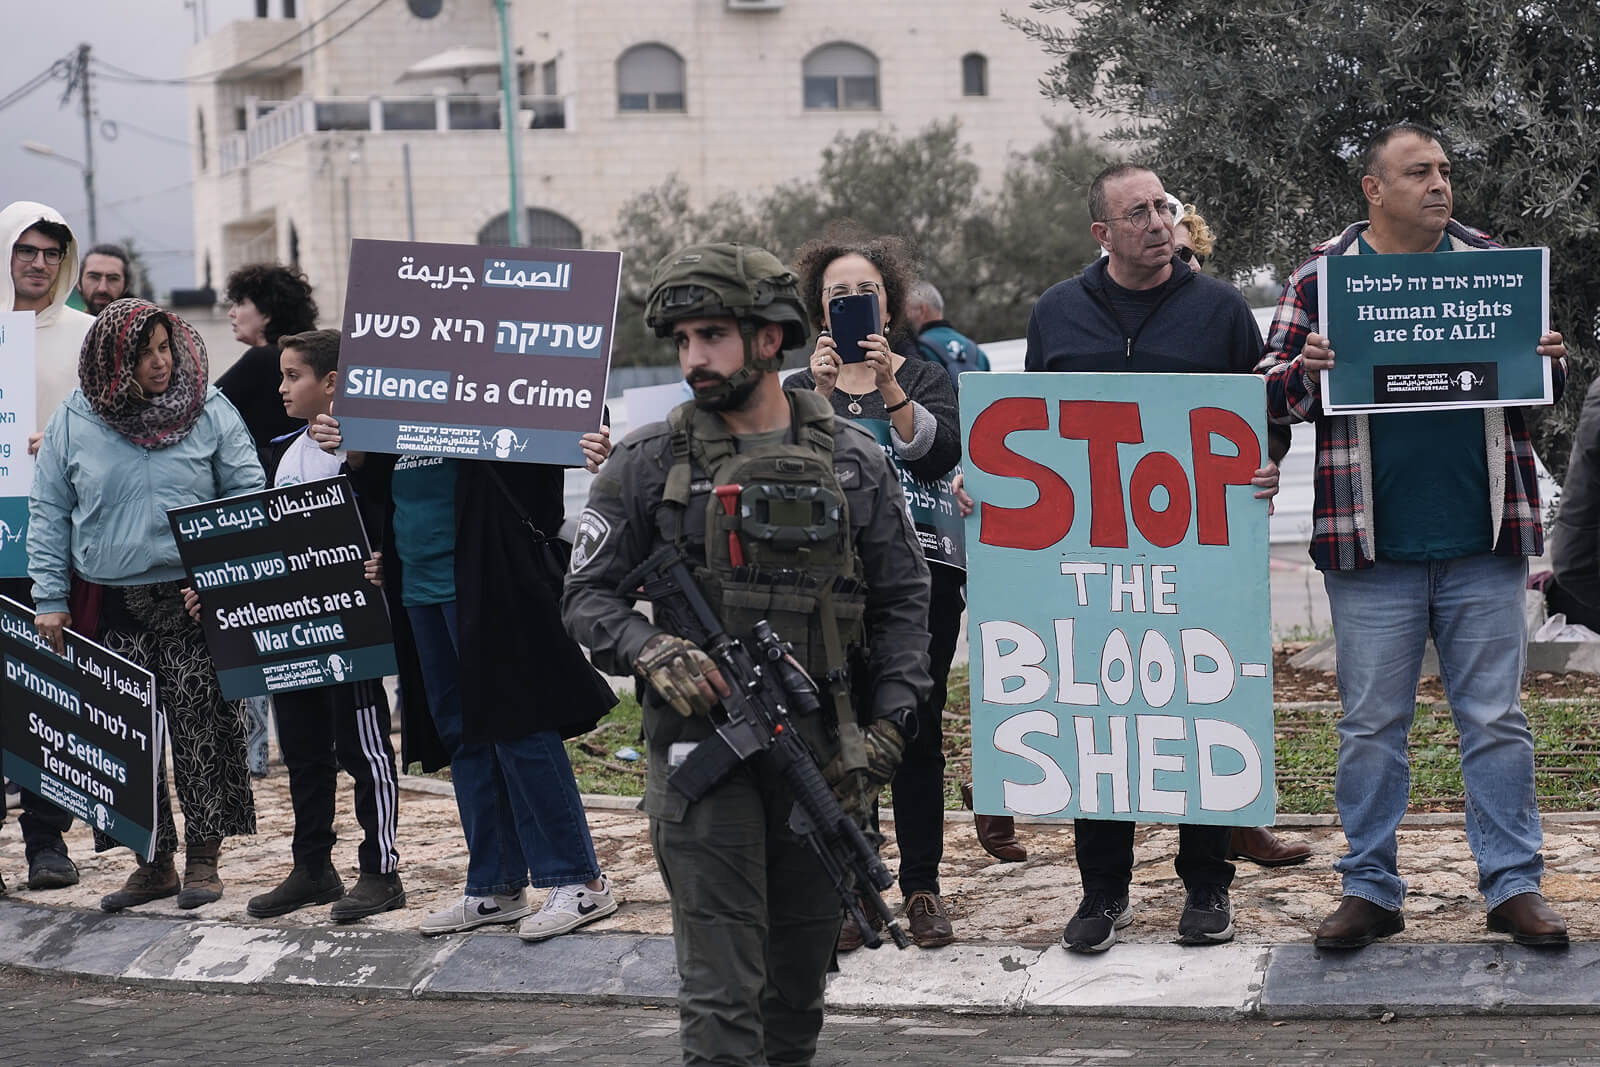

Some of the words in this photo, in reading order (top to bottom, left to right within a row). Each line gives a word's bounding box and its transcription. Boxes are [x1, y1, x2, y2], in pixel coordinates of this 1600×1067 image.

[397, 256, 475, 290] جريمة
[484, 261, 570, 288] الصمت
[1346, 273, 1403, 293] לכולם!
[1407, 276, 1427, 292] זה
[1431, 275, 1468, 291] אדם
[1472, 273, 1523, 290] זכויות
[1357, 303, 1436, 321] Human
[1441, 300, 1512, 322] Rights
[350, 312, 421, 339] פשע
[430, 316, 485, 344] היא
[496, 320, 602, 354] שתיקה
[1373, 328, 1407, 343] are
[1412, 324, 1445, 342] for
[1449, 322, 1496, 340] ALL!
[346, 368, 448, 400] Silence
[454, 374, 477, 402] is
[483, 384, 500, 404] a
[507, 378, 592, 409] Crime
[396, 442, 443, 452] COMBATANTS
[442, 445, 456, 454] FOR
[418, 457, 443, 467] PEACE
[268, 484, 346, 522] الاستيطان
[938, 498, 953, 516] זה
[179, 517, 214, 540] حرب
[217, 507, 265, 530] جريمة
[251, 558, 285, 580] פשע
[288, 544, 362, 572] התנחליות
[194, 561, 249, 589] מלחמה
[1060, 561, 1179, 614] THE
[215, 595, 321, 630] Settlements
[323, 593, 352, 612] are
[354, 590, 367, 607] a
[252, 629, 289, 652] War
[291, 622, 345, 646] Crime
[76, 656, 111, 691] إرهاب
[978, 617, 1268, 708] BLOOD-
[6, 659, 80, 715] המתנחלים
[113, 670, 151, 707] أوقفوا
[84, 702, 127, 740] לטרור
[28, 712, 65, 752] Stop
[67, 733, 127, 784] Settlers
[132, 728, 147, 752] די
[40, 745, 115, 806] Terrorism
[993, 709, 1263, 816] SHED
